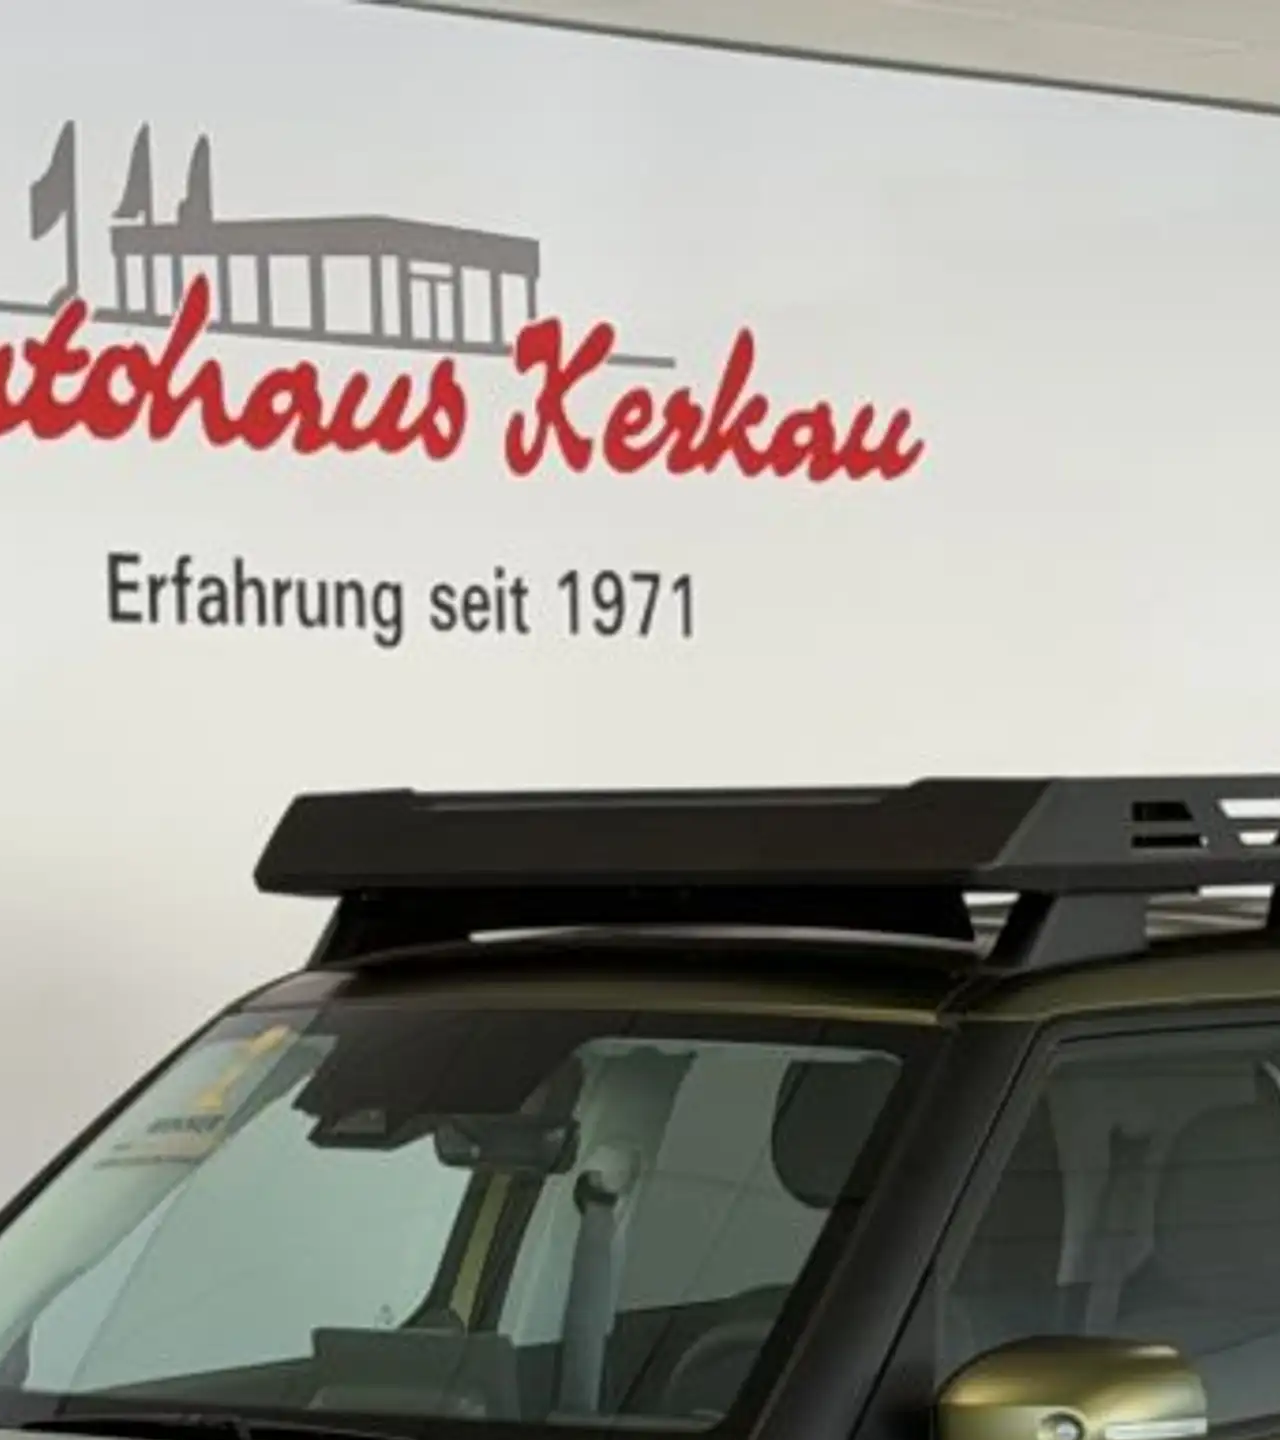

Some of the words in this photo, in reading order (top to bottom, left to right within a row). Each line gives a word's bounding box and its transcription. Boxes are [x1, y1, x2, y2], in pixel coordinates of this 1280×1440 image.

[504, 318, 926, 483] Kerkau
[106, 552, 404, 648] Erfahrung
[429, 566, 530, 635] seit
[557, 569, 695, 638] 1971
